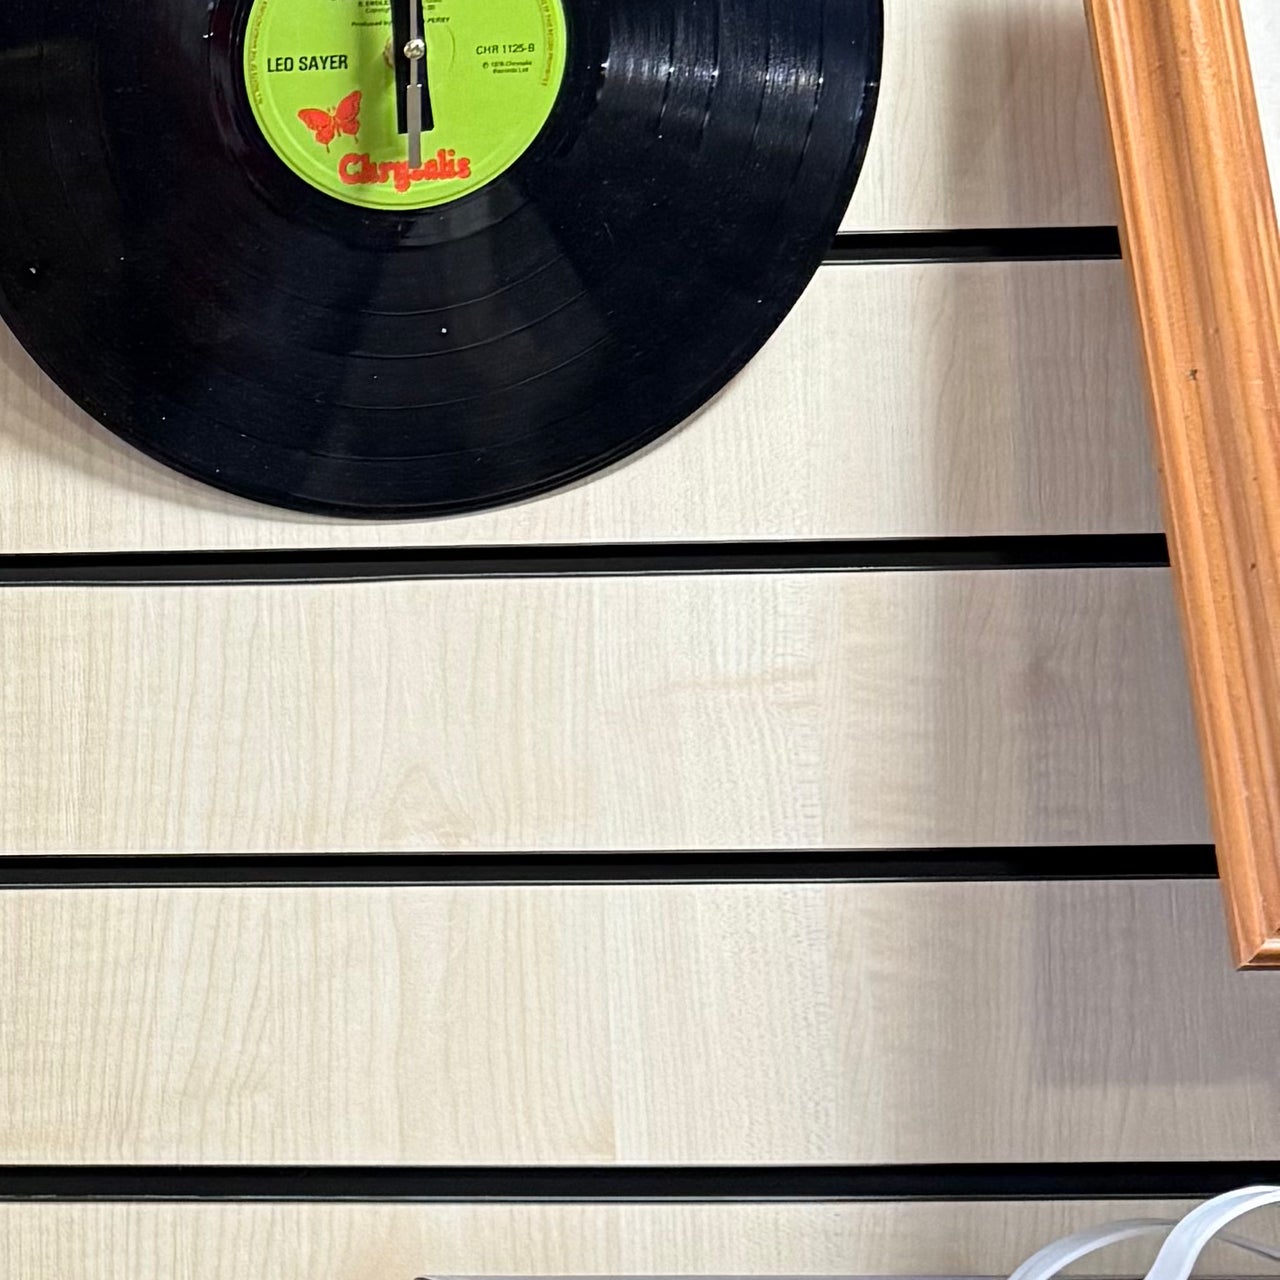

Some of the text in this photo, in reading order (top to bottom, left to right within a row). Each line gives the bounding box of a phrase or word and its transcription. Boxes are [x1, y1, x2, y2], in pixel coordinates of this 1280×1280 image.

[476, 45, 499, 55] CHR
[267, 55, 348, 72] LEO SAYER
